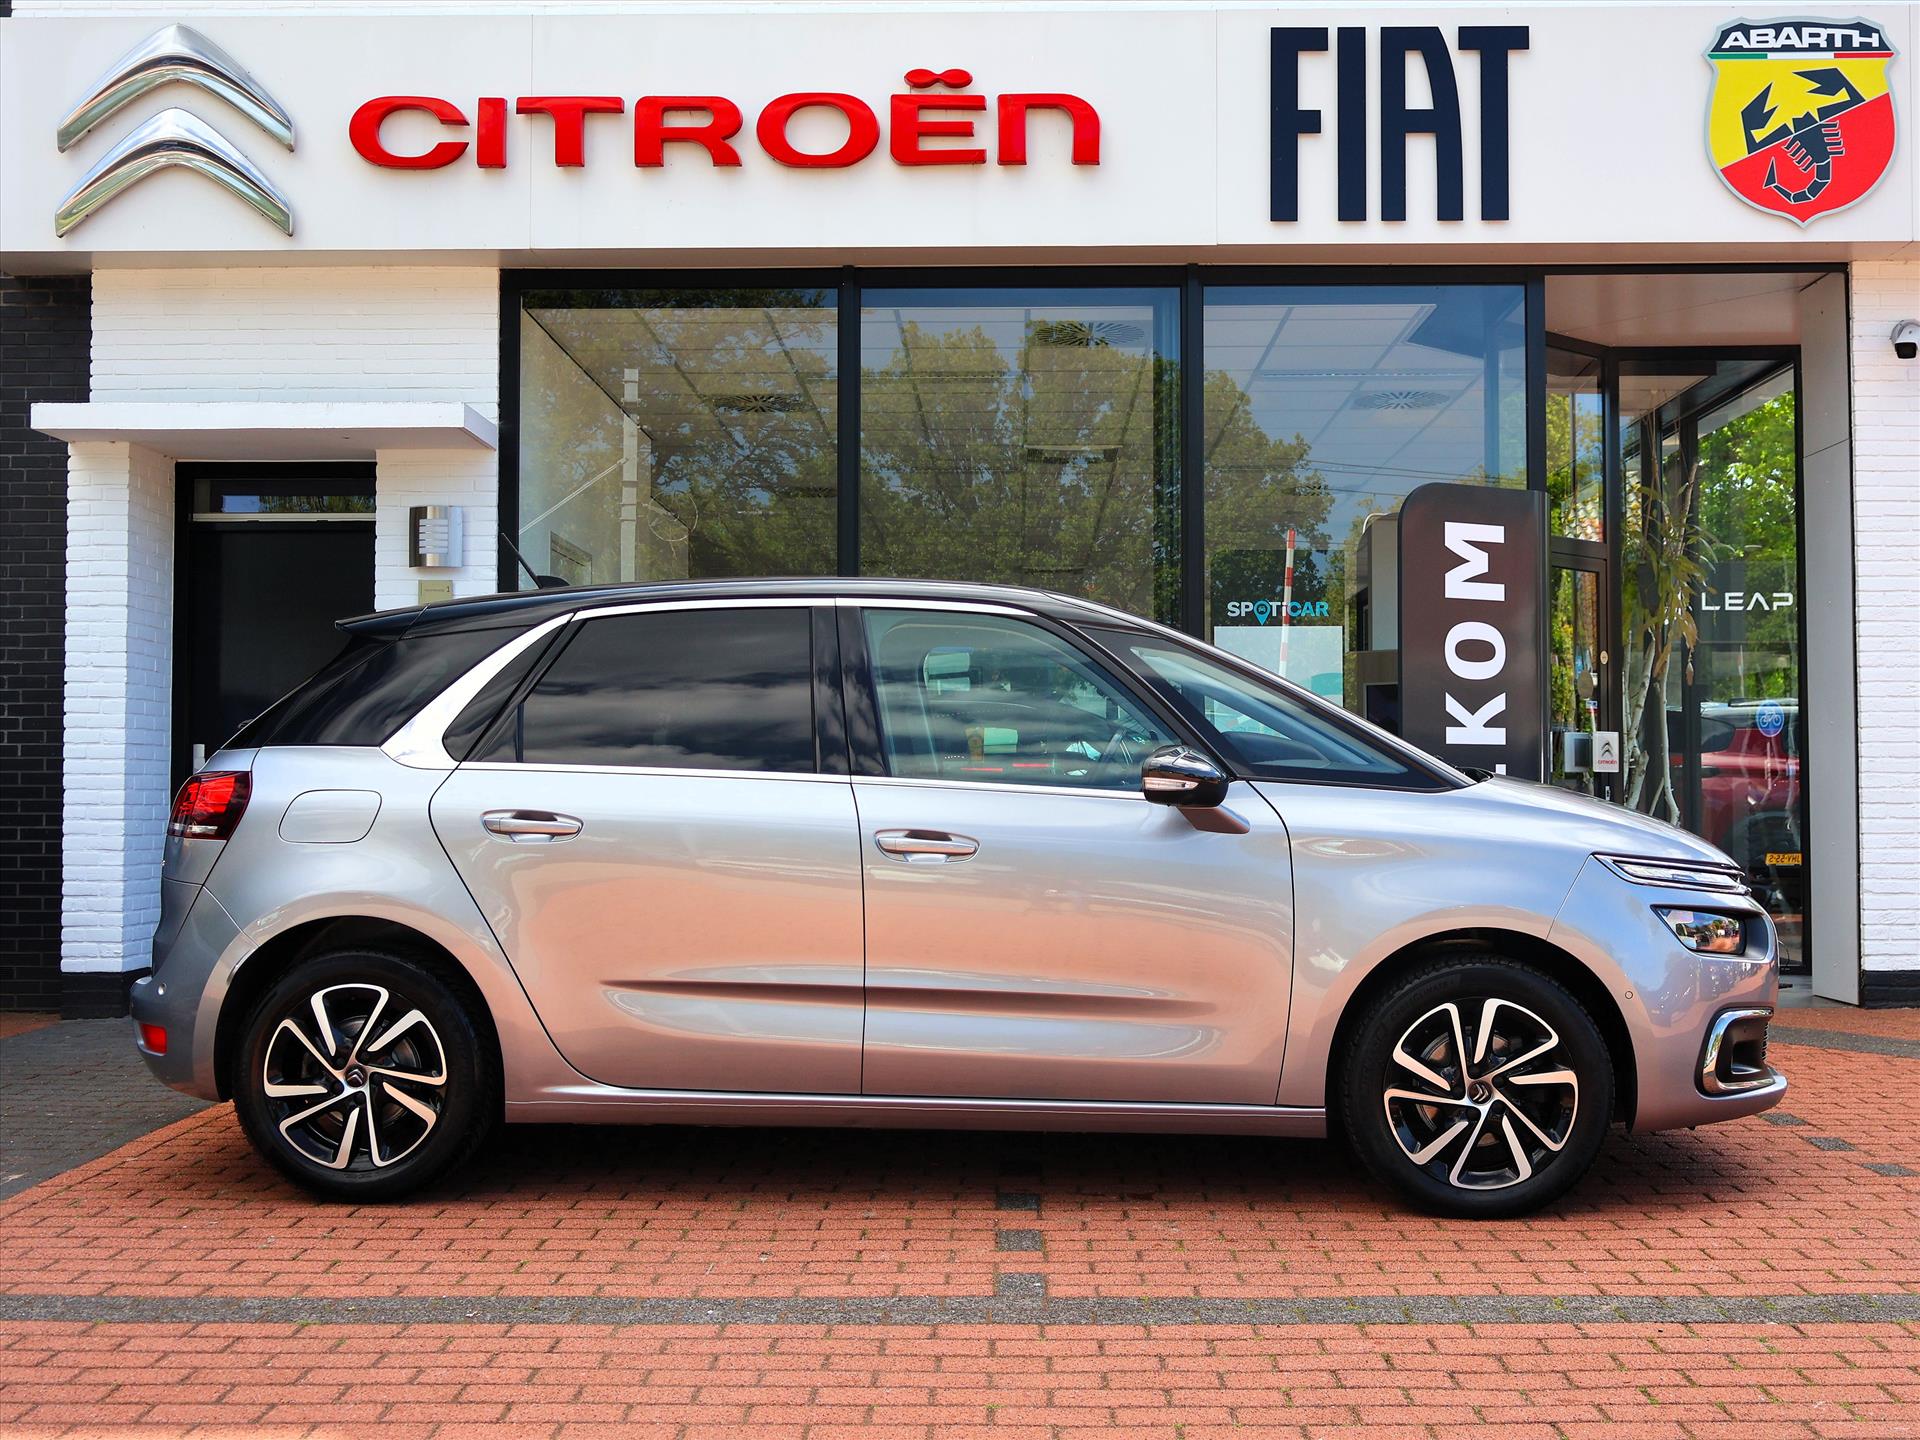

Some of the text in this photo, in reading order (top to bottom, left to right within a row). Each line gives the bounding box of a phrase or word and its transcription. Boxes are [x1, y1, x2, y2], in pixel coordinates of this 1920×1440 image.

[1721, 26, 1880, 49] ABARTH
[348, 68, 1102, 169] CITROËN
[1270, 26, 1529, 221] FIAT
[1444, 521, 1507, 775] KOM
